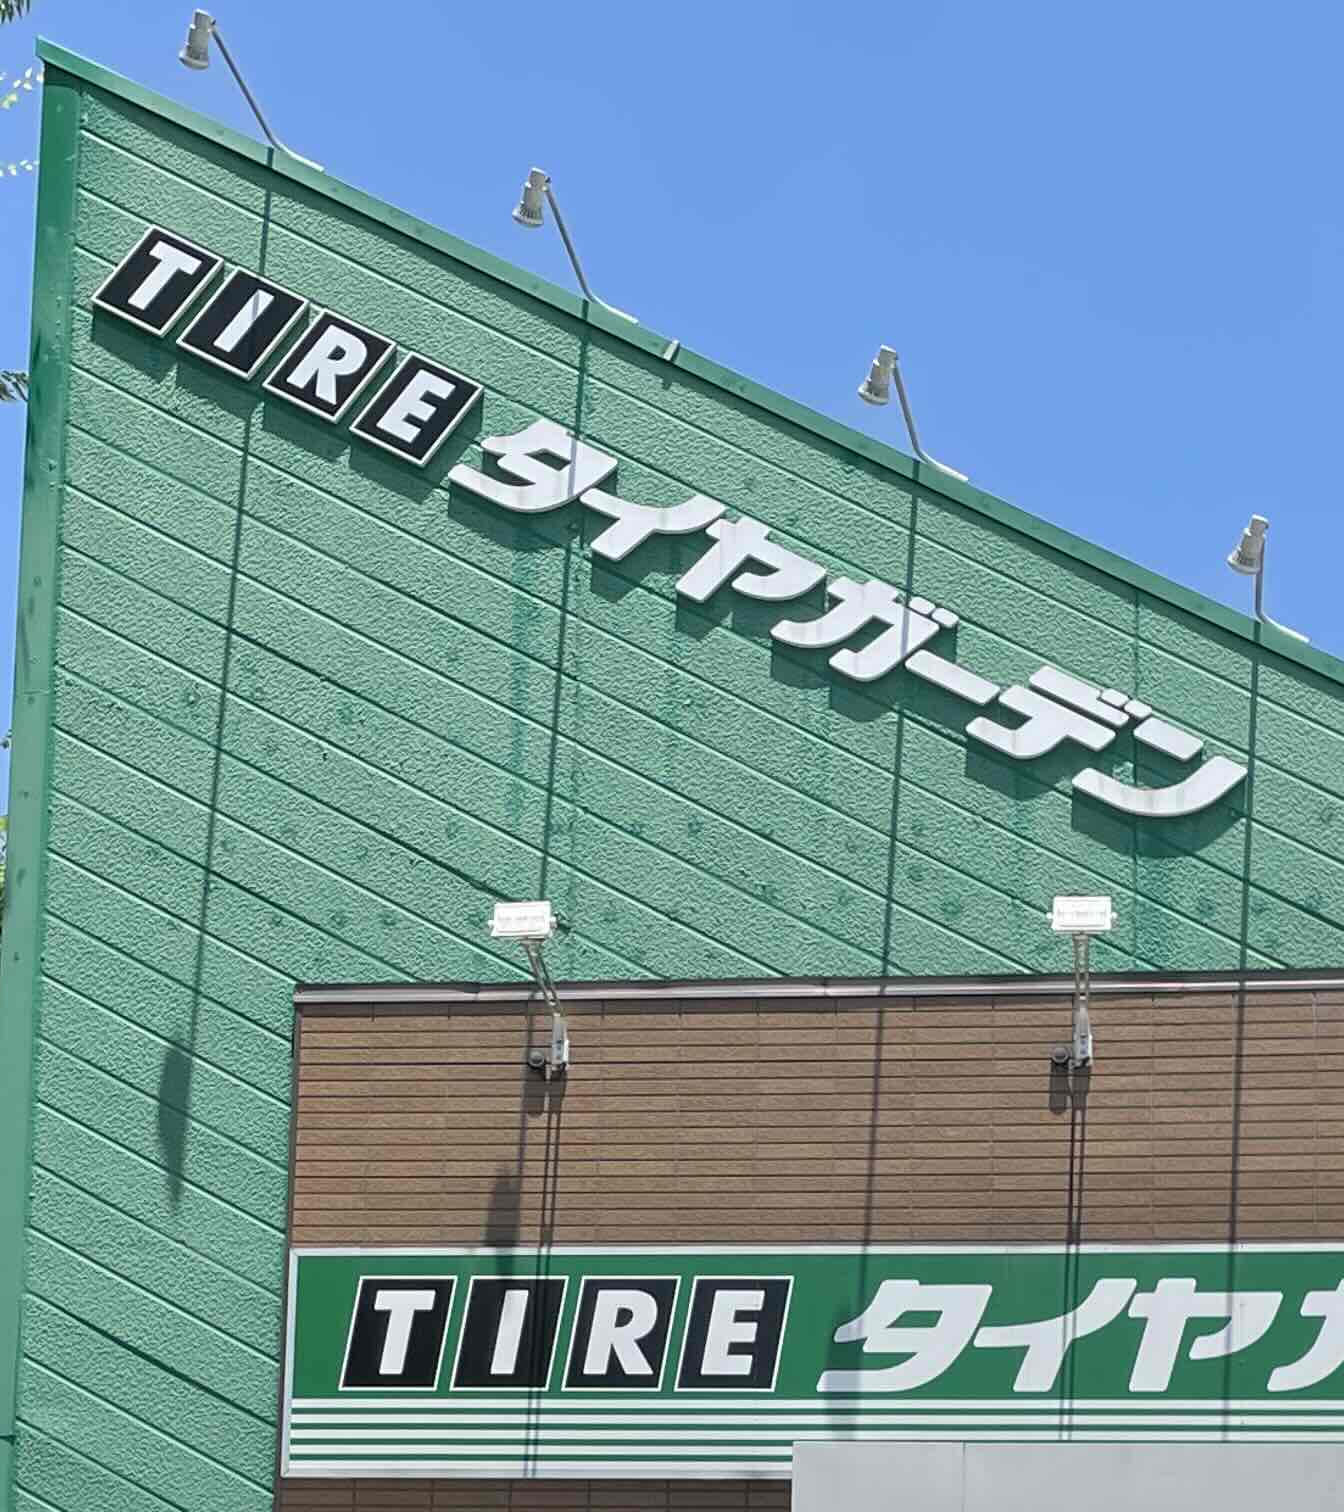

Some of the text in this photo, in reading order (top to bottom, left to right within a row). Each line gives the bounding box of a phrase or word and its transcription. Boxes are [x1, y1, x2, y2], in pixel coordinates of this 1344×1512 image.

[127, 240, 457, 443] TIRE
[447, 416, 1248, 817] タイヤガーデン
[373, 1288, 766, 1376] TIRE
